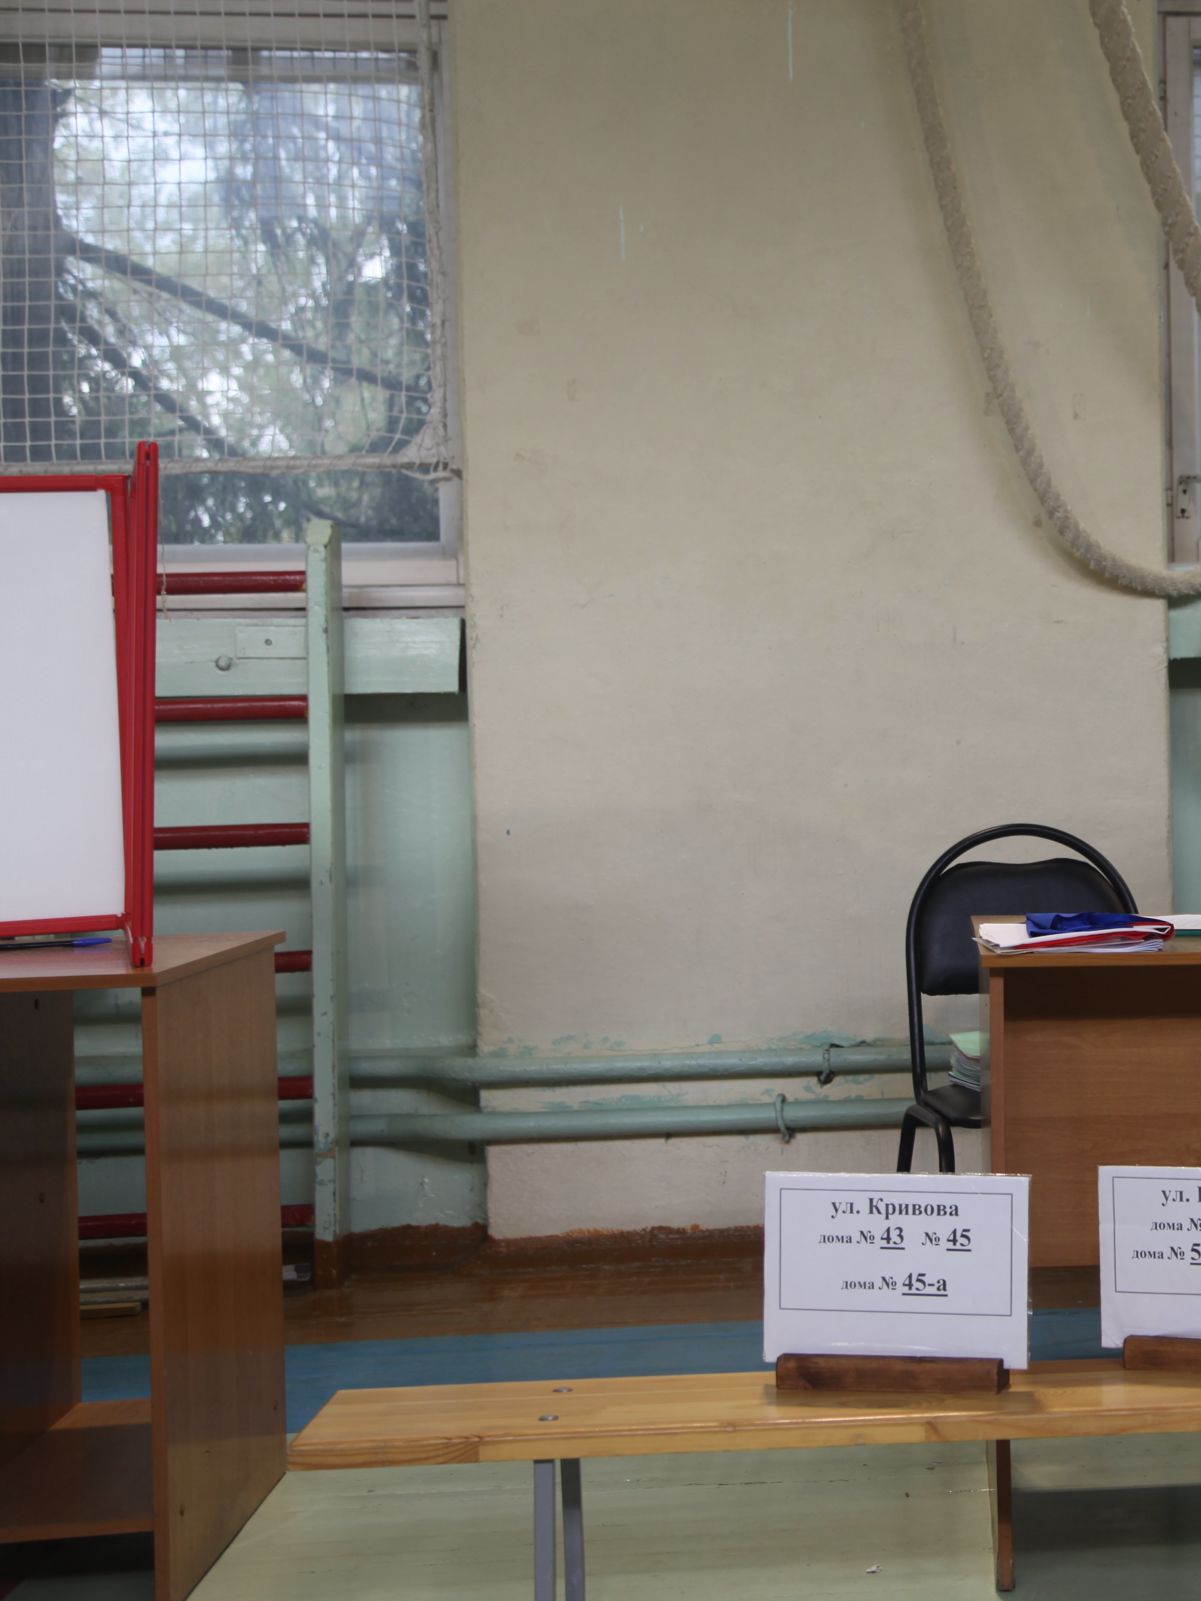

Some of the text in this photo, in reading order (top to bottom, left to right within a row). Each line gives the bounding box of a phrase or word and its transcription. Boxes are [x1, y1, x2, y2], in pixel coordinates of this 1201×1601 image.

[1161, 1189, 1190, 1206] ул.
[831, 1198, 959, 1220] ул. Кривова
[1150, 1221, 1183, 1232] дома
[818, 1227, 971, 1247] дома № 43 № 45
[1131, 1249, 1164, 1260] дома
[1167, 1247, 1185, 1260] №
[841, 1273, 947, 1292] дома № 45-а
